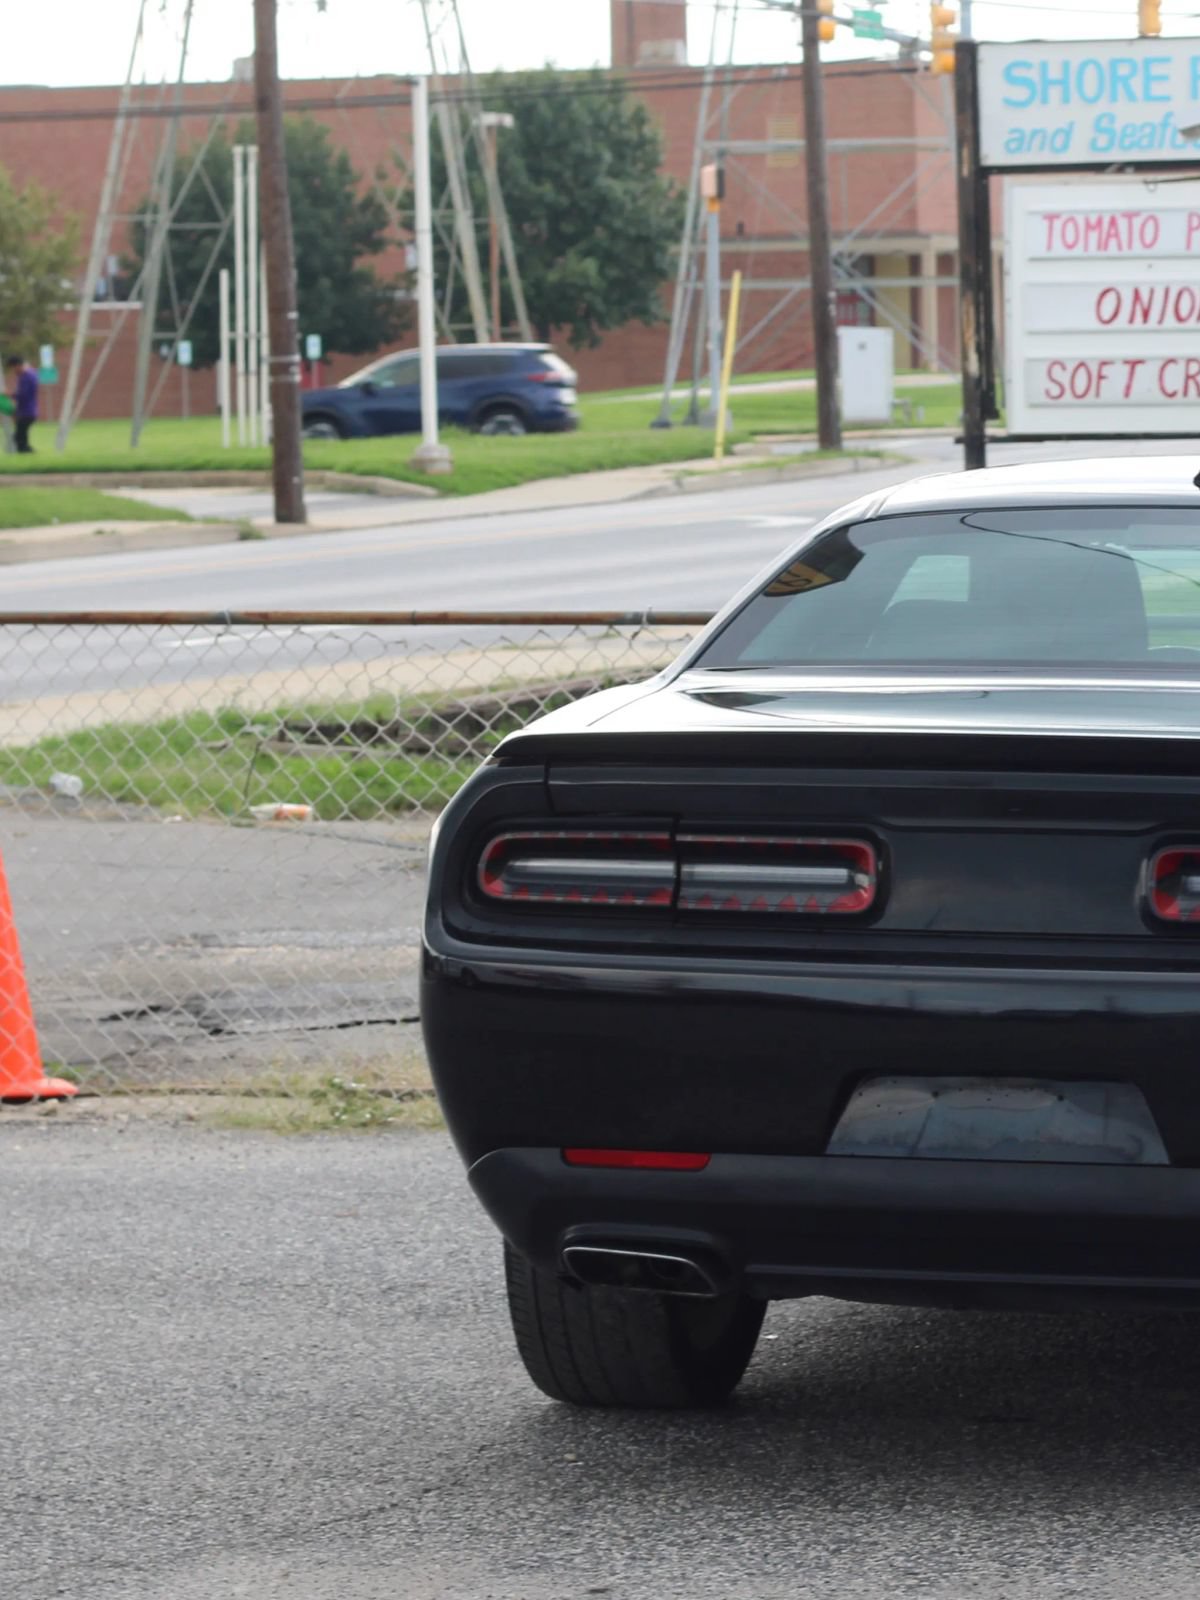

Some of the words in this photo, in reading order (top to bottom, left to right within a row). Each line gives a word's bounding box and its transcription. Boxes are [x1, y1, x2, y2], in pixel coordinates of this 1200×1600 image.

[1001, 56, 1172, 108] SHORE
[1003, 120, 1074, 154] and
[1042, 211, 1160, 252] TOMATO
[1045, 360, 1146, 400] SOFT
